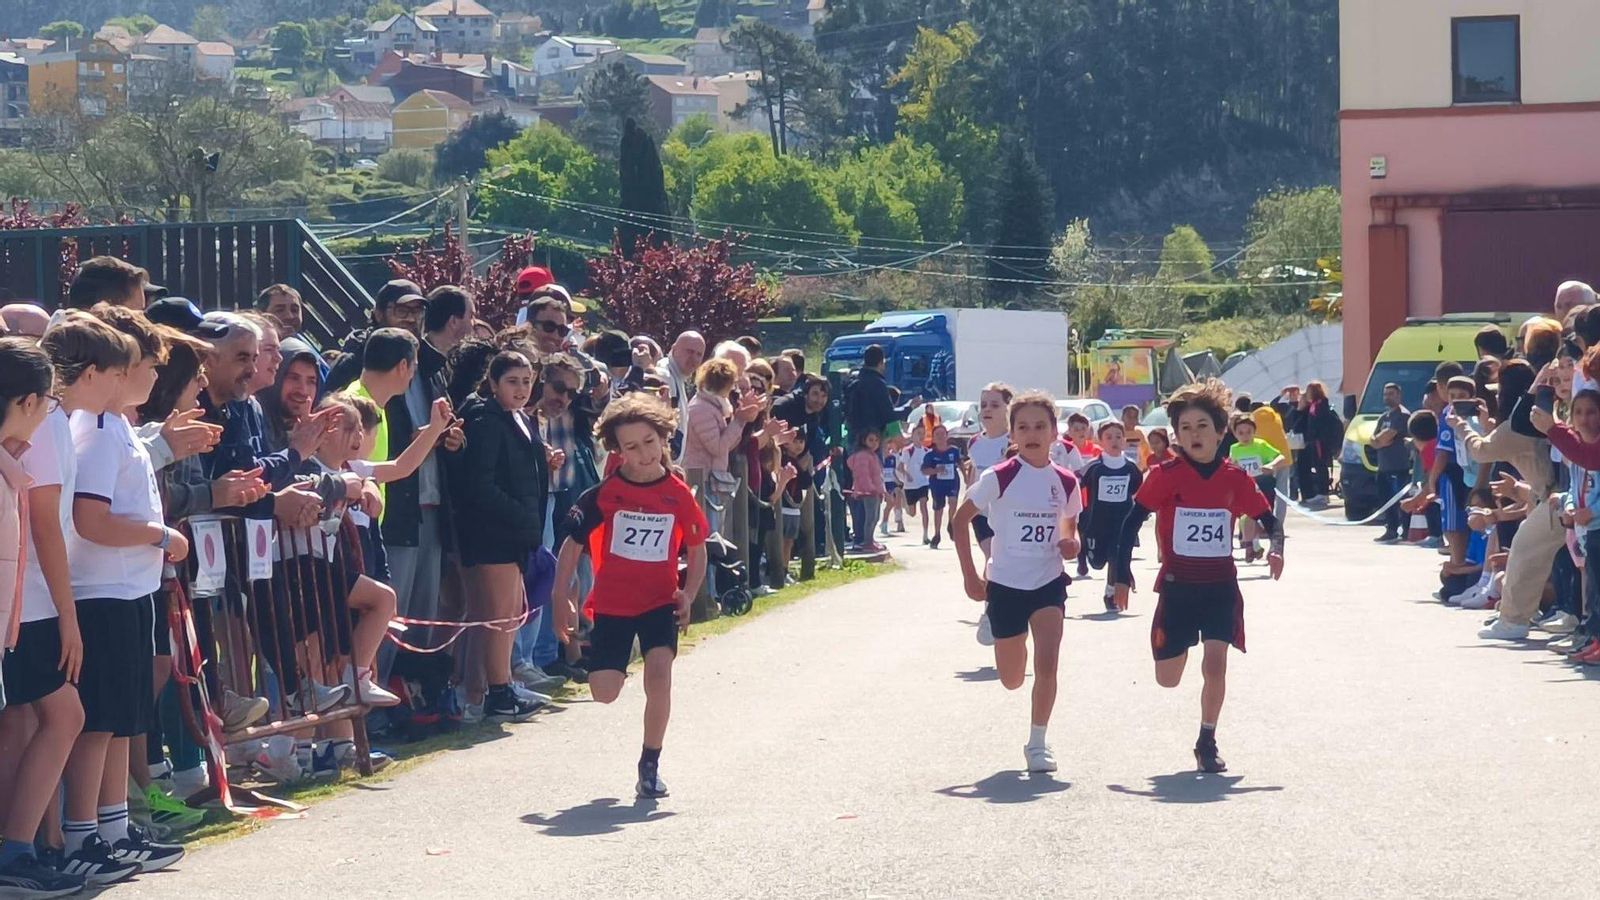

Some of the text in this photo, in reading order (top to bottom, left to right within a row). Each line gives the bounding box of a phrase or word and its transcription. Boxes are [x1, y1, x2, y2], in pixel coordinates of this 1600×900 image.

[1106, 484, 1126, 495] 257
[624, 527, 664, 547] 277
[1020, 524, 1056, 543] 287
[1186, 524, 1225, 543] 254
